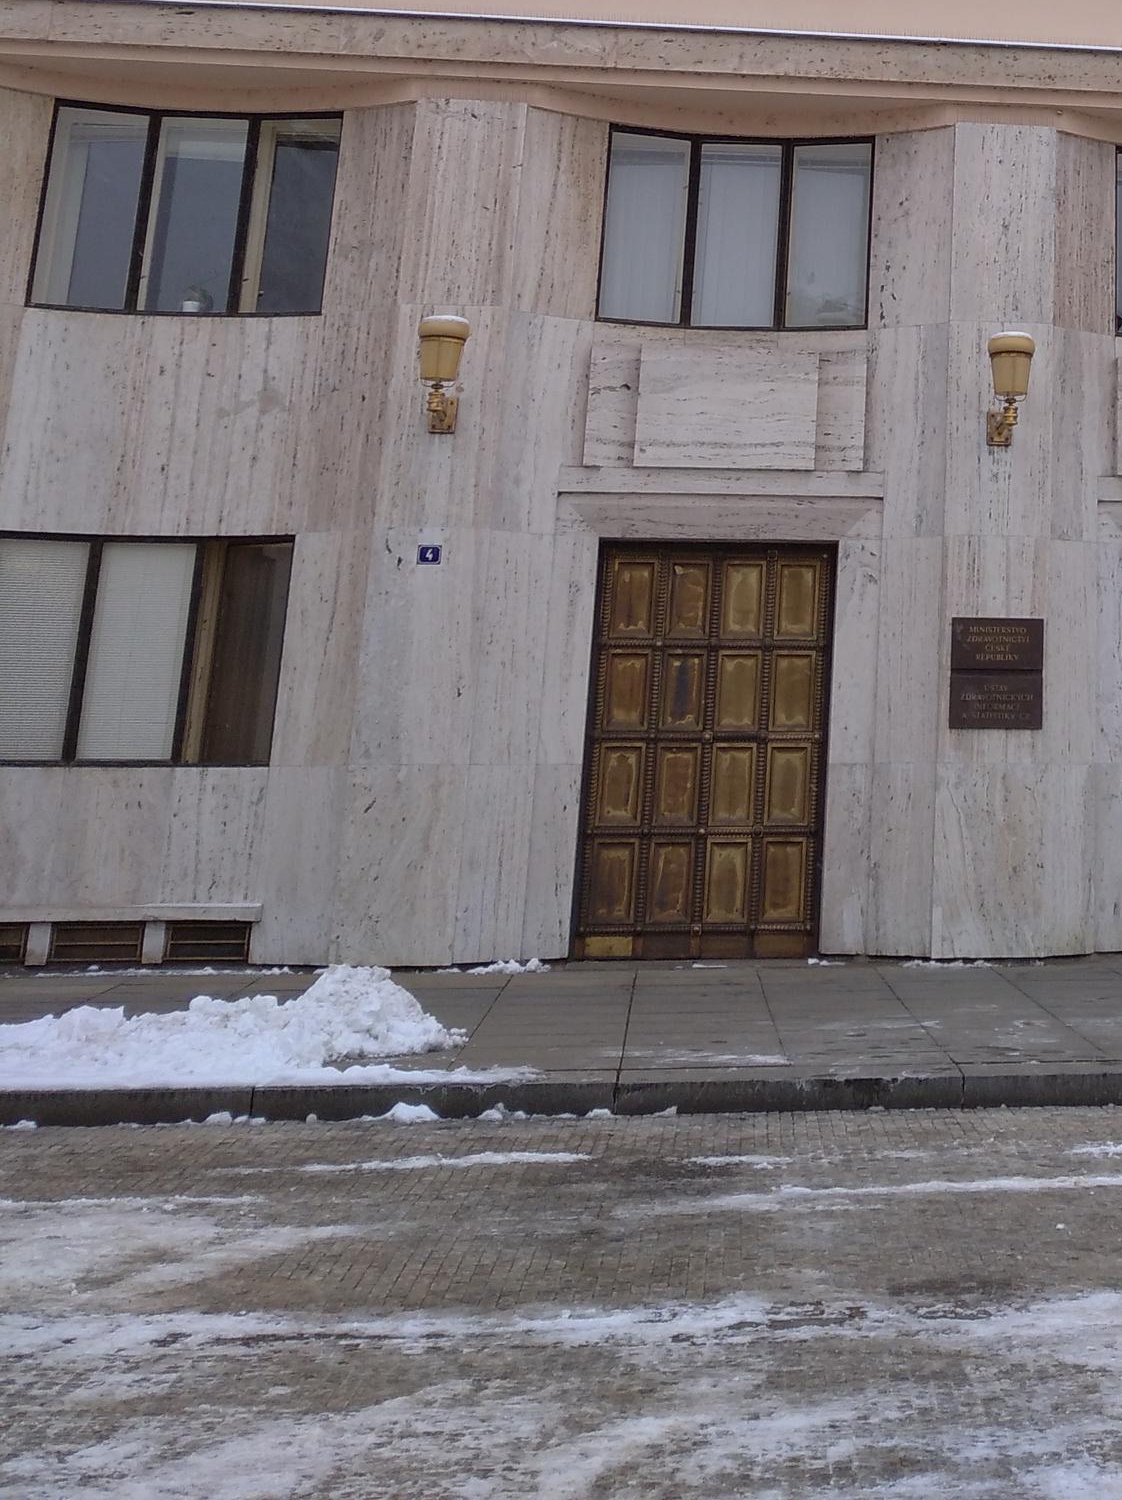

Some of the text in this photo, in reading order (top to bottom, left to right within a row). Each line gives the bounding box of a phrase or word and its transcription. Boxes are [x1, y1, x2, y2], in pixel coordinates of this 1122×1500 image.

[425, 548, 434, 561] 4
[968, 625, 1028, 634] MINISTERSTVO
[975, 652, 1020, 661] REPUBLIKY
